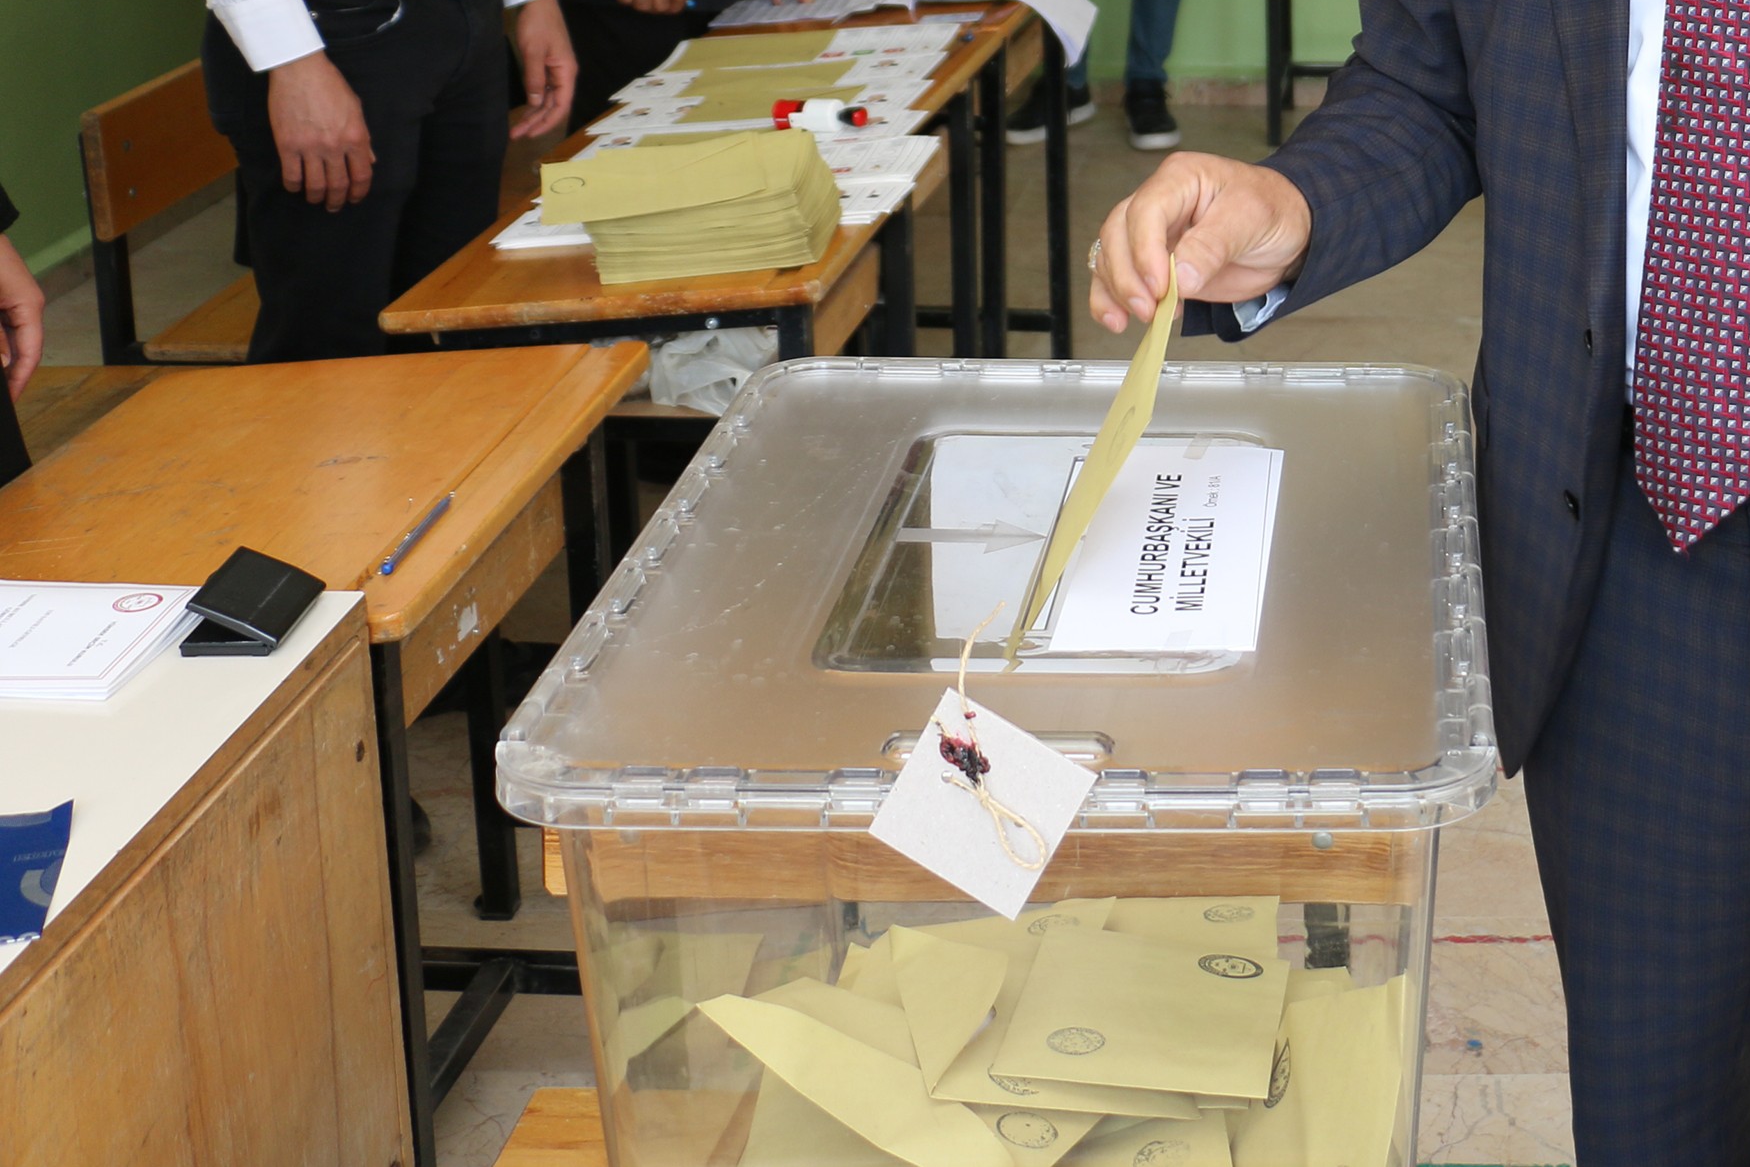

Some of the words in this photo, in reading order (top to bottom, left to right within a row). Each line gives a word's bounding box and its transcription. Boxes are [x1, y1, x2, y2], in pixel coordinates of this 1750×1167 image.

[1154, 474, 1182, 490] VE
[1130, 493, 1180, 615] CUMHURBAŞKANI
[1169, 518, 1215, 611] MİLLETVEKİLİ
